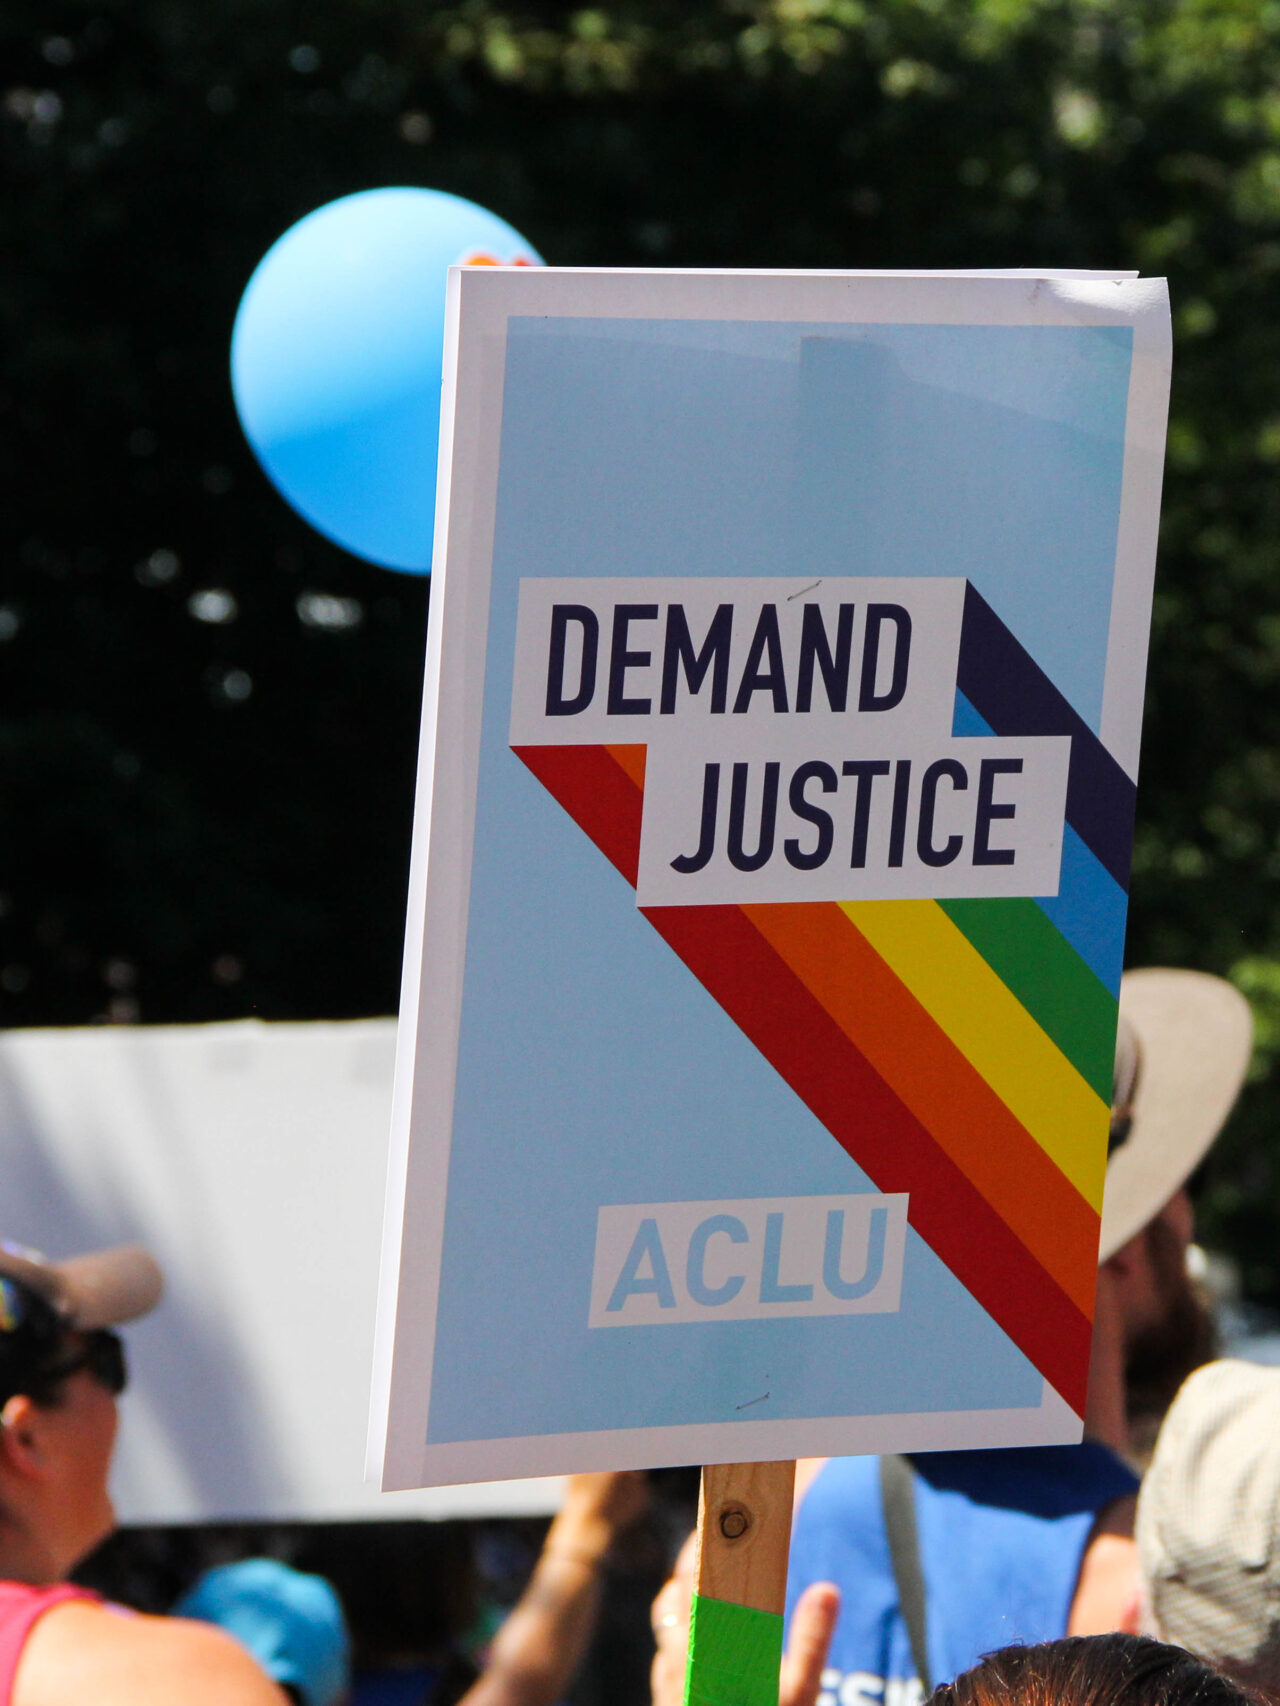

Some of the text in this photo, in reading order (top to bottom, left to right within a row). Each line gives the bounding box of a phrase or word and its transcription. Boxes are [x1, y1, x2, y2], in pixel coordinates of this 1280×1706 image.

[545, 603, 913, 716] DEMAND
[670, 758, 1024, 874] JUSTICE
[605, 1208, 888, 1312] ACLU
